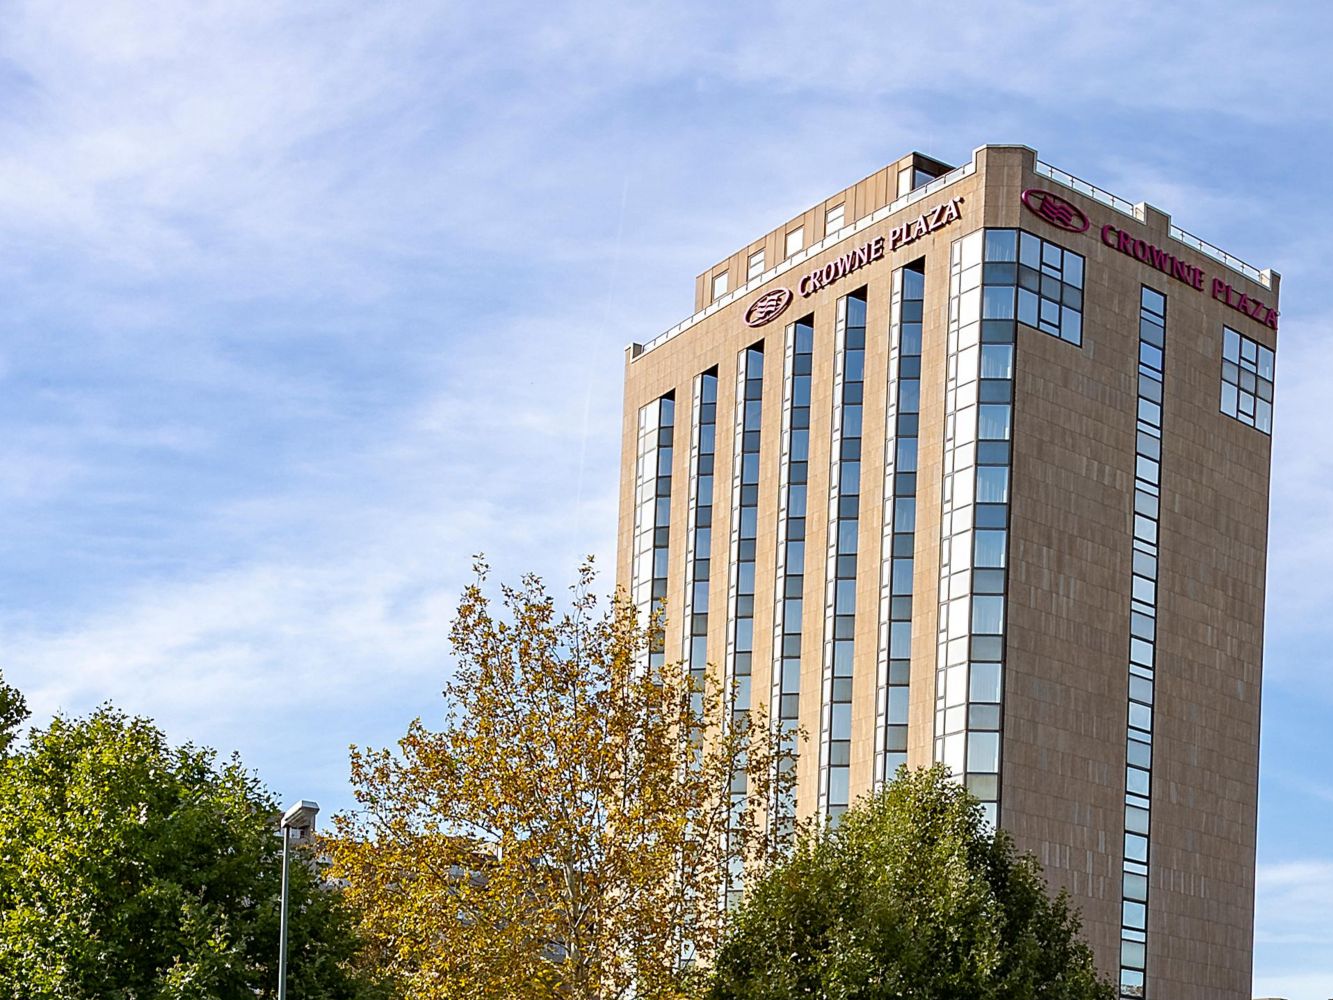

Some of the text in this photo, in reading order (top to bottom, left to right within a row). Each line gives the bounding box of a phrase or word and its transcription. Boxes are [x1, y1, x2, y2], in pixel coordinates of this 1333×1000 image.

[796, 199, 962, 298] CROWNE PLAZA
[1100, 224, 1277, 331] CROWNE PLAZA
